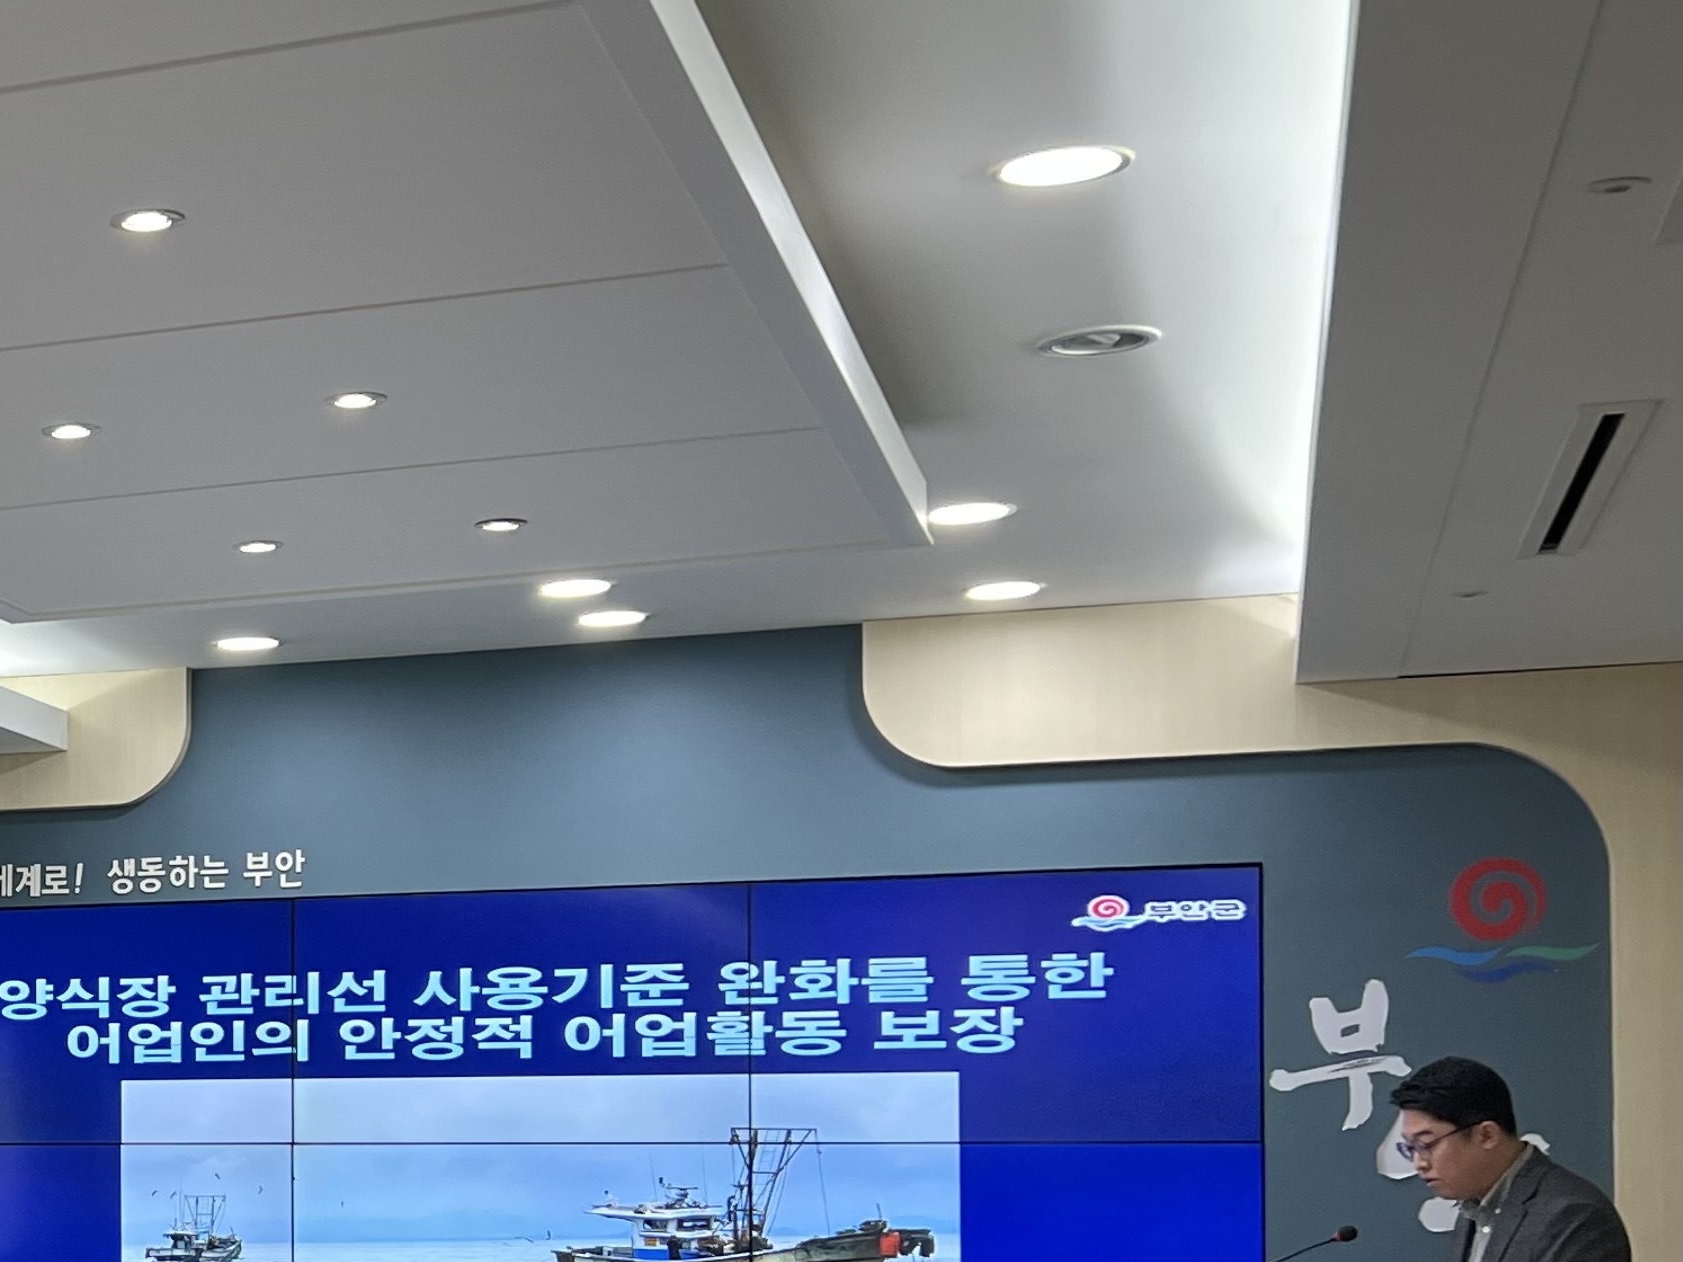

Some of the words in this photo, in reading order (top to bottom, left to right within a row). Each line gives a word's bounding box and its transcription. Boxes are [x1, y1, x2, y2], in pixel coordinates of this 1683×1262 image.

[106, 854, 230, 895] 생동하는
[242, 848, 306, 888] 부안
[1144, 899, 1247, 923] 부안군
[198, 969, 390, 1016] 관리선
[412, 962, 691, 1012] 사용기준
[717, 956, 934, 1006] 완화를
[960, 952, 1114, 1002] 통한
[66, 1018, 311, 1064] 어업인의
[337, 1015, 535, 1061] 안정적
[563, 1009, 848, 1058] 어업활동
[873, 1006, 1025, 1054] 보장
